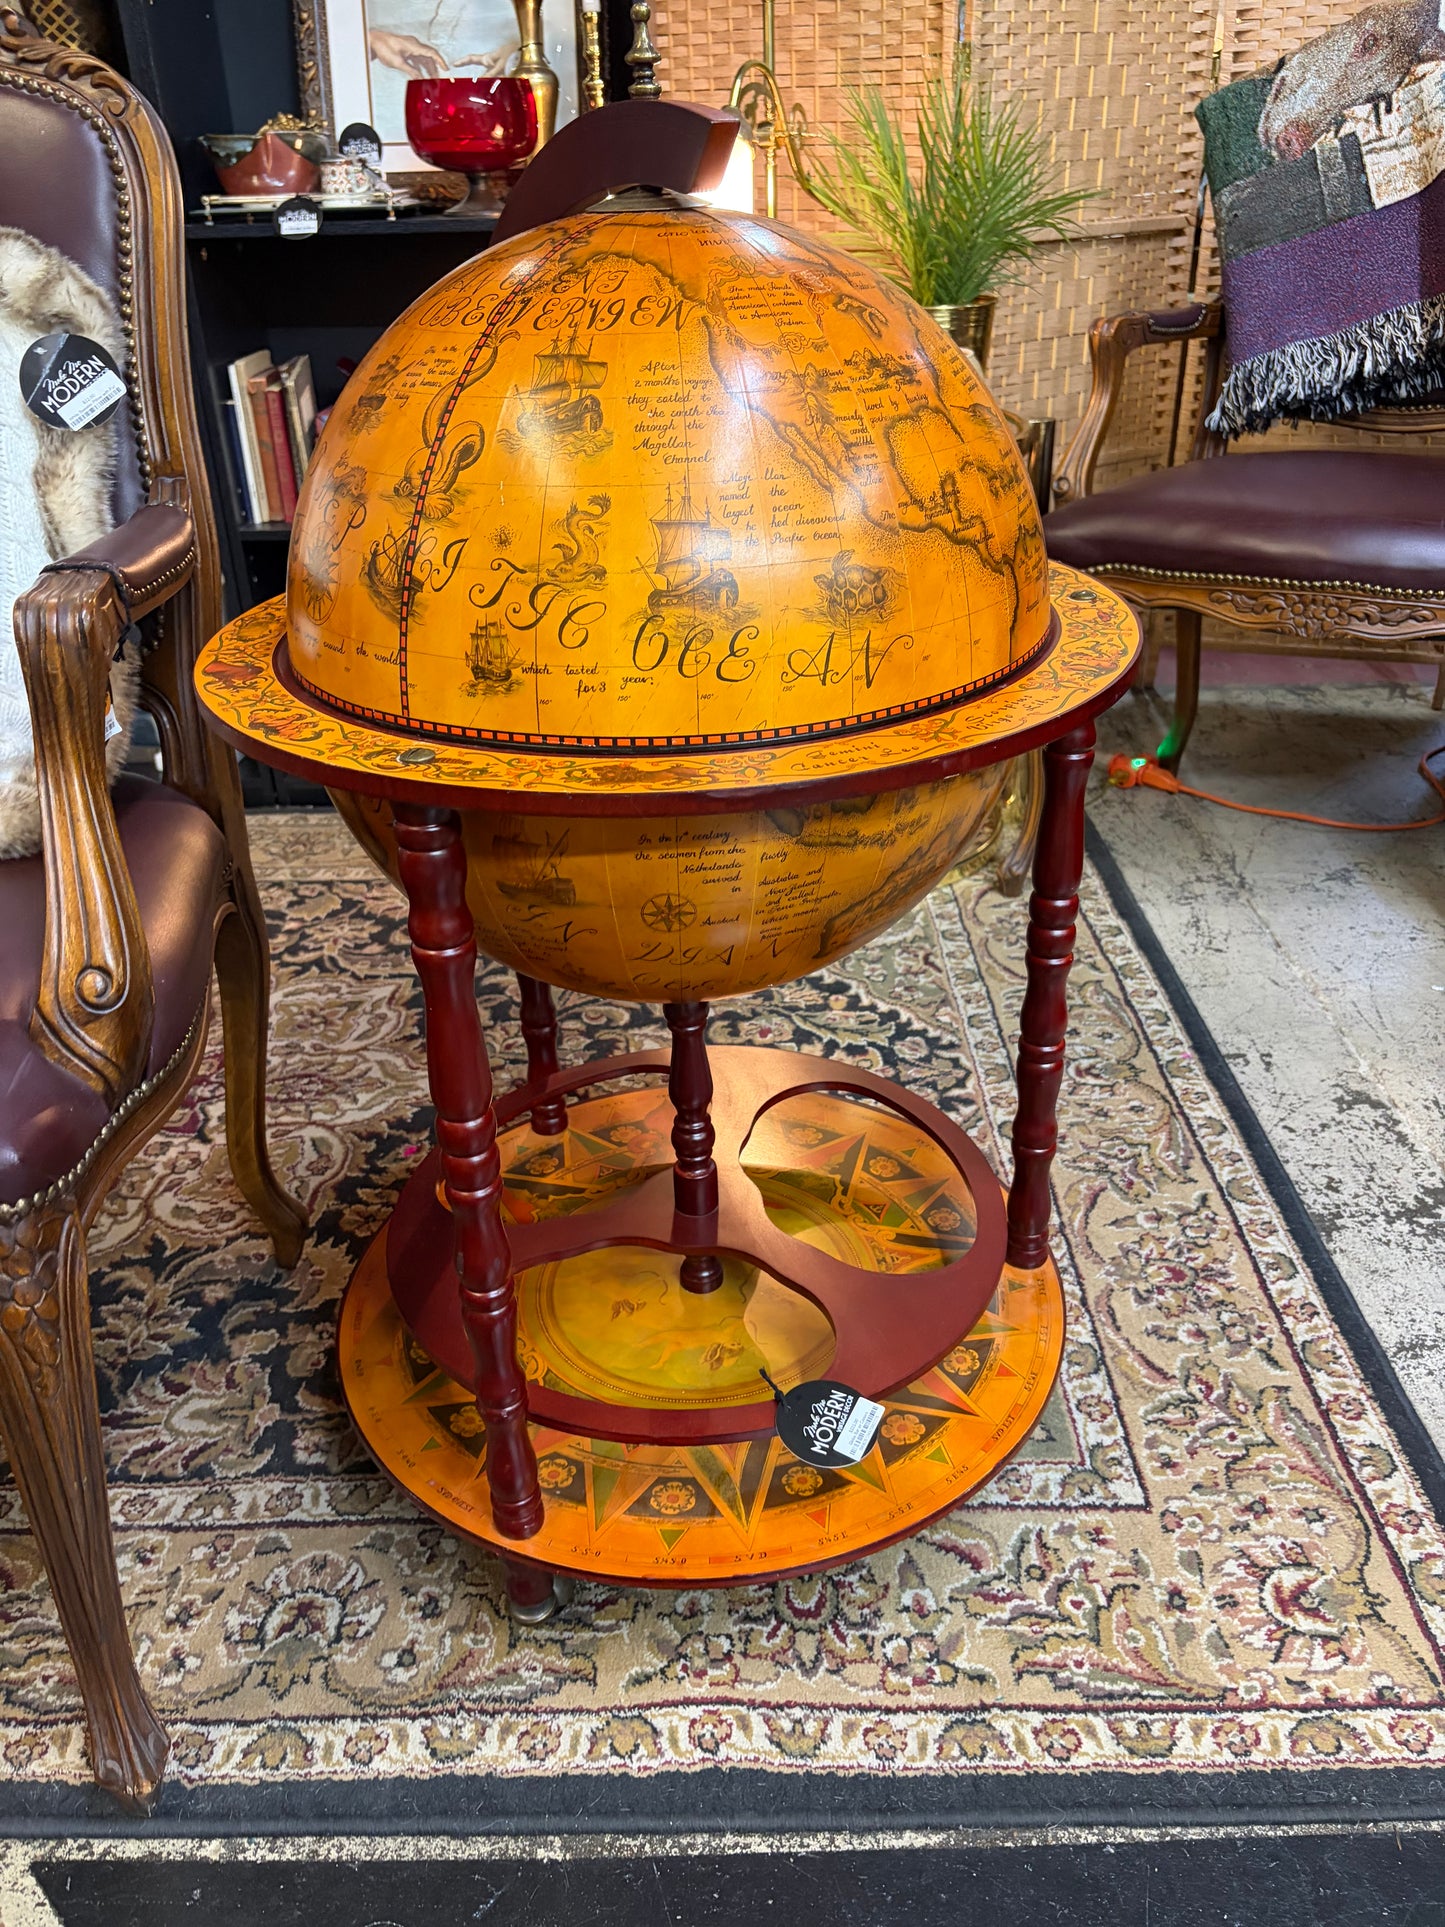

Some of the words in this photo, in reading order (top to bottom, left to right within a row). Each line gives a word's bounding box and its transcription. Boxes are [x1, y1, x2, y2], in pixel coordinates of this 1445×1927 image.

[639, 360, 679, 375] After
[41, 354, 106, 414] MODERN
[643, 375, 680, 387] months
[627, 393, 650, 411] they
[634, 419, 677, 439] through
[686, 420, 706, 430] the
[633, 436, 696, 457] Magellan
[663, 450, 713, 465] Channel
[769, 484, 791, 497] the
[632, 614, 914, 690] OCEAN
[521, 661, 553, 675] which
[565, 662, 600, 676] lasted
[575, 679, 597, 698] for
[811, 1399, 826, 1416] Me
[803, 1413, 821, 1439] Make
[810, 1389, 847, 1456] MODERN
